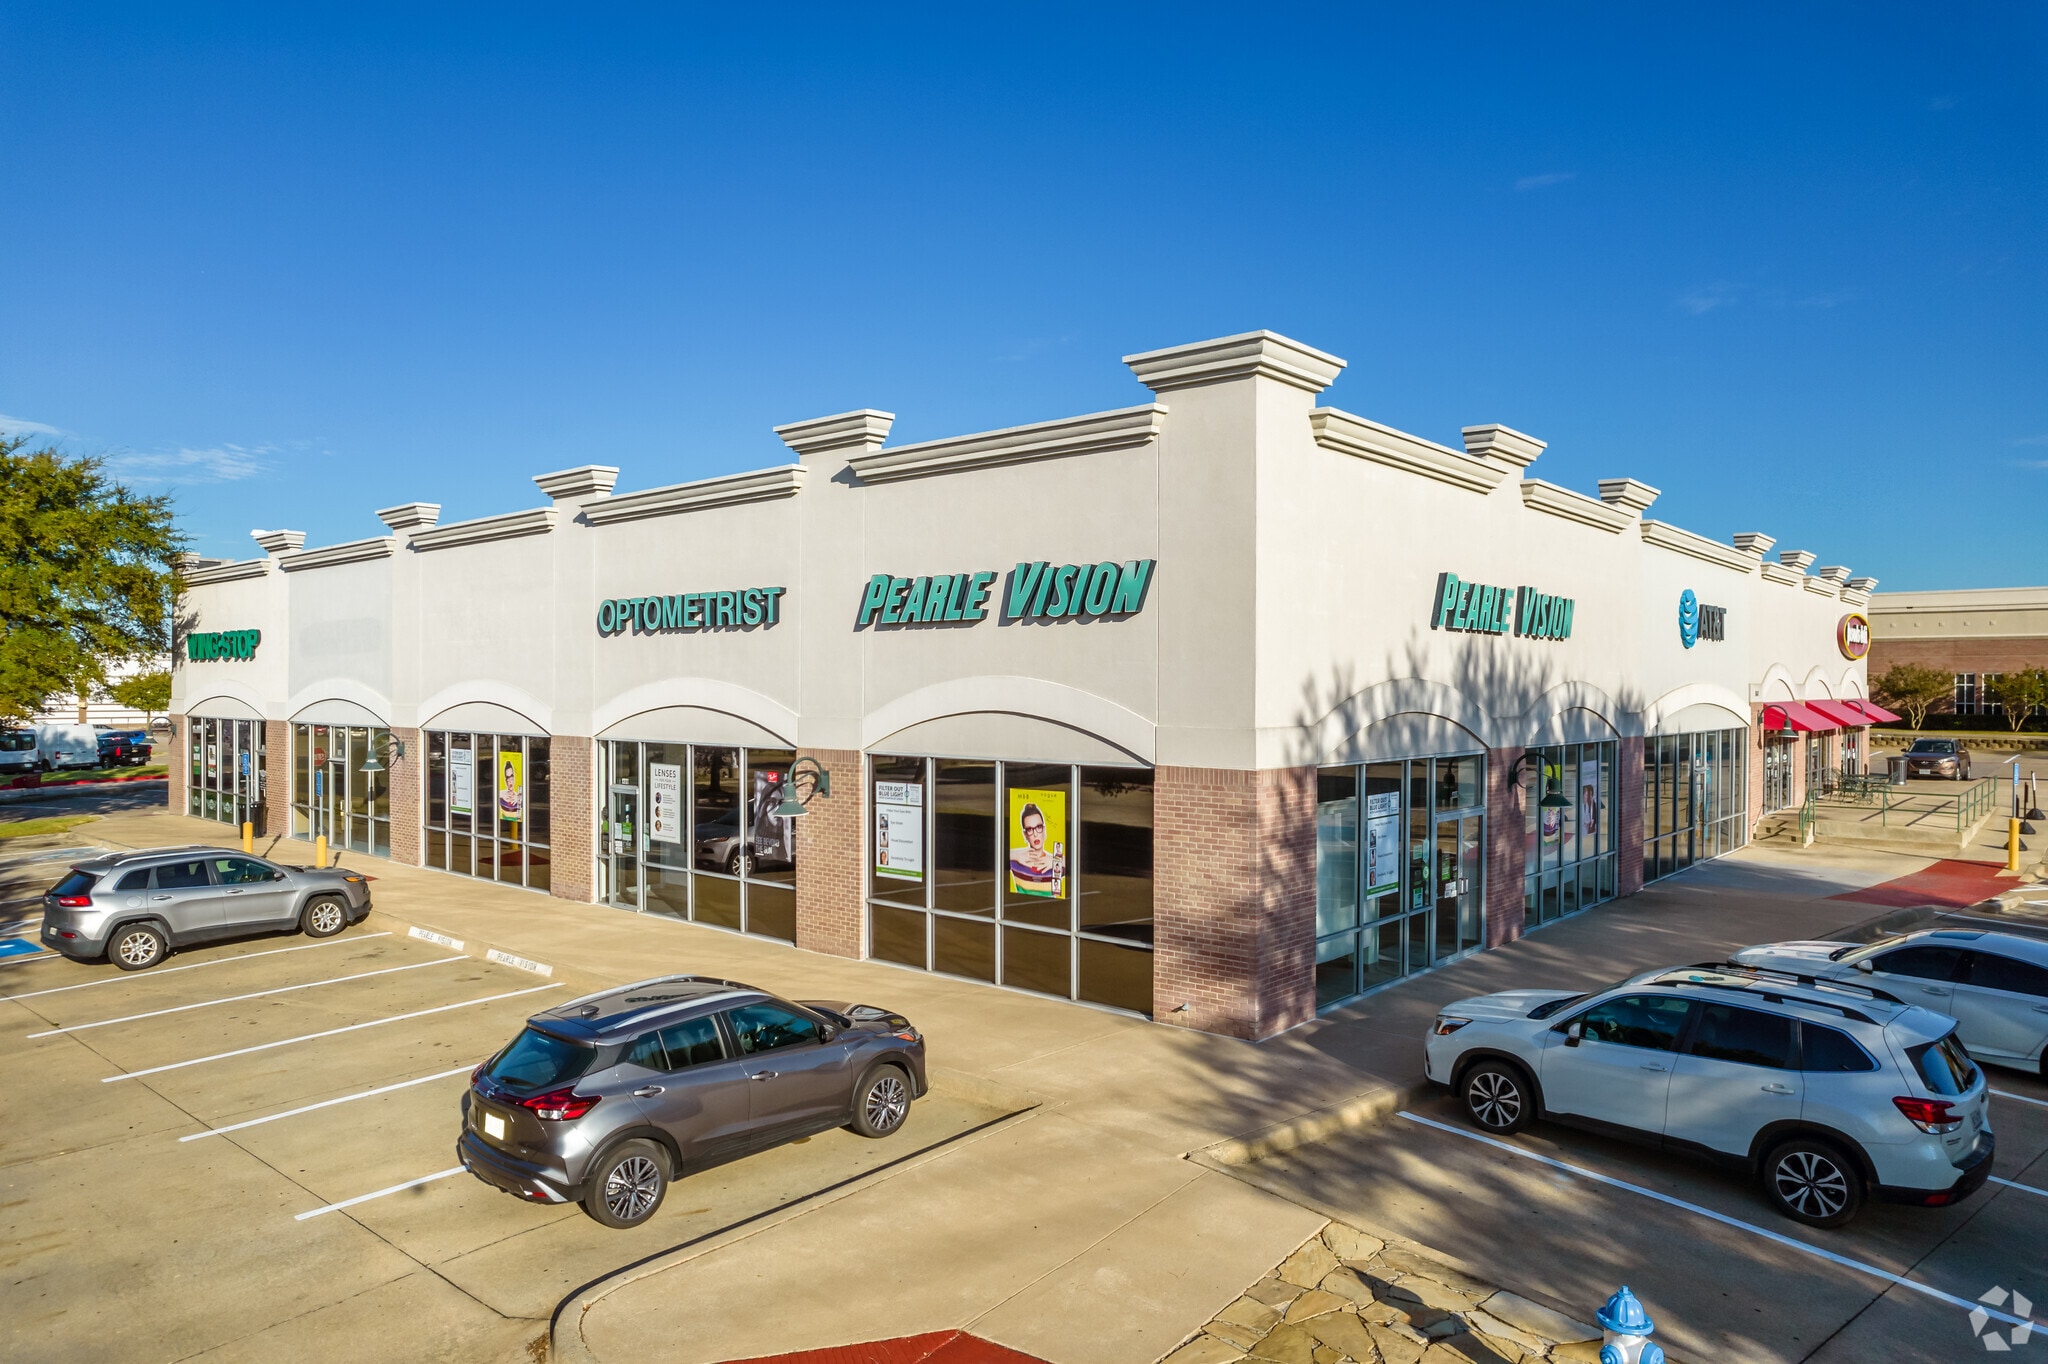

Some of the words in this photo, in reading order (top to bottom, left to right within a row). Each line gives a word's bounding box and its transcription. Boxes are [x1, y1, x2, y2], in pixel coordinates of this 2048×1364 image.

[599, 587, 781, 633] OPTOMETRIST
[859, 572, 994, 625] PEARLE
[1007, 559, 1152, 618] VISION
[1438, 572, 1515, 633] PEARLE
[1521, 585, 1576, 639] VISION
[1700, 604, 1727, 641] AT&T
[654, 768, 677, 778] LENSES
[654, 782, 677, 791] LIFESTYLE
